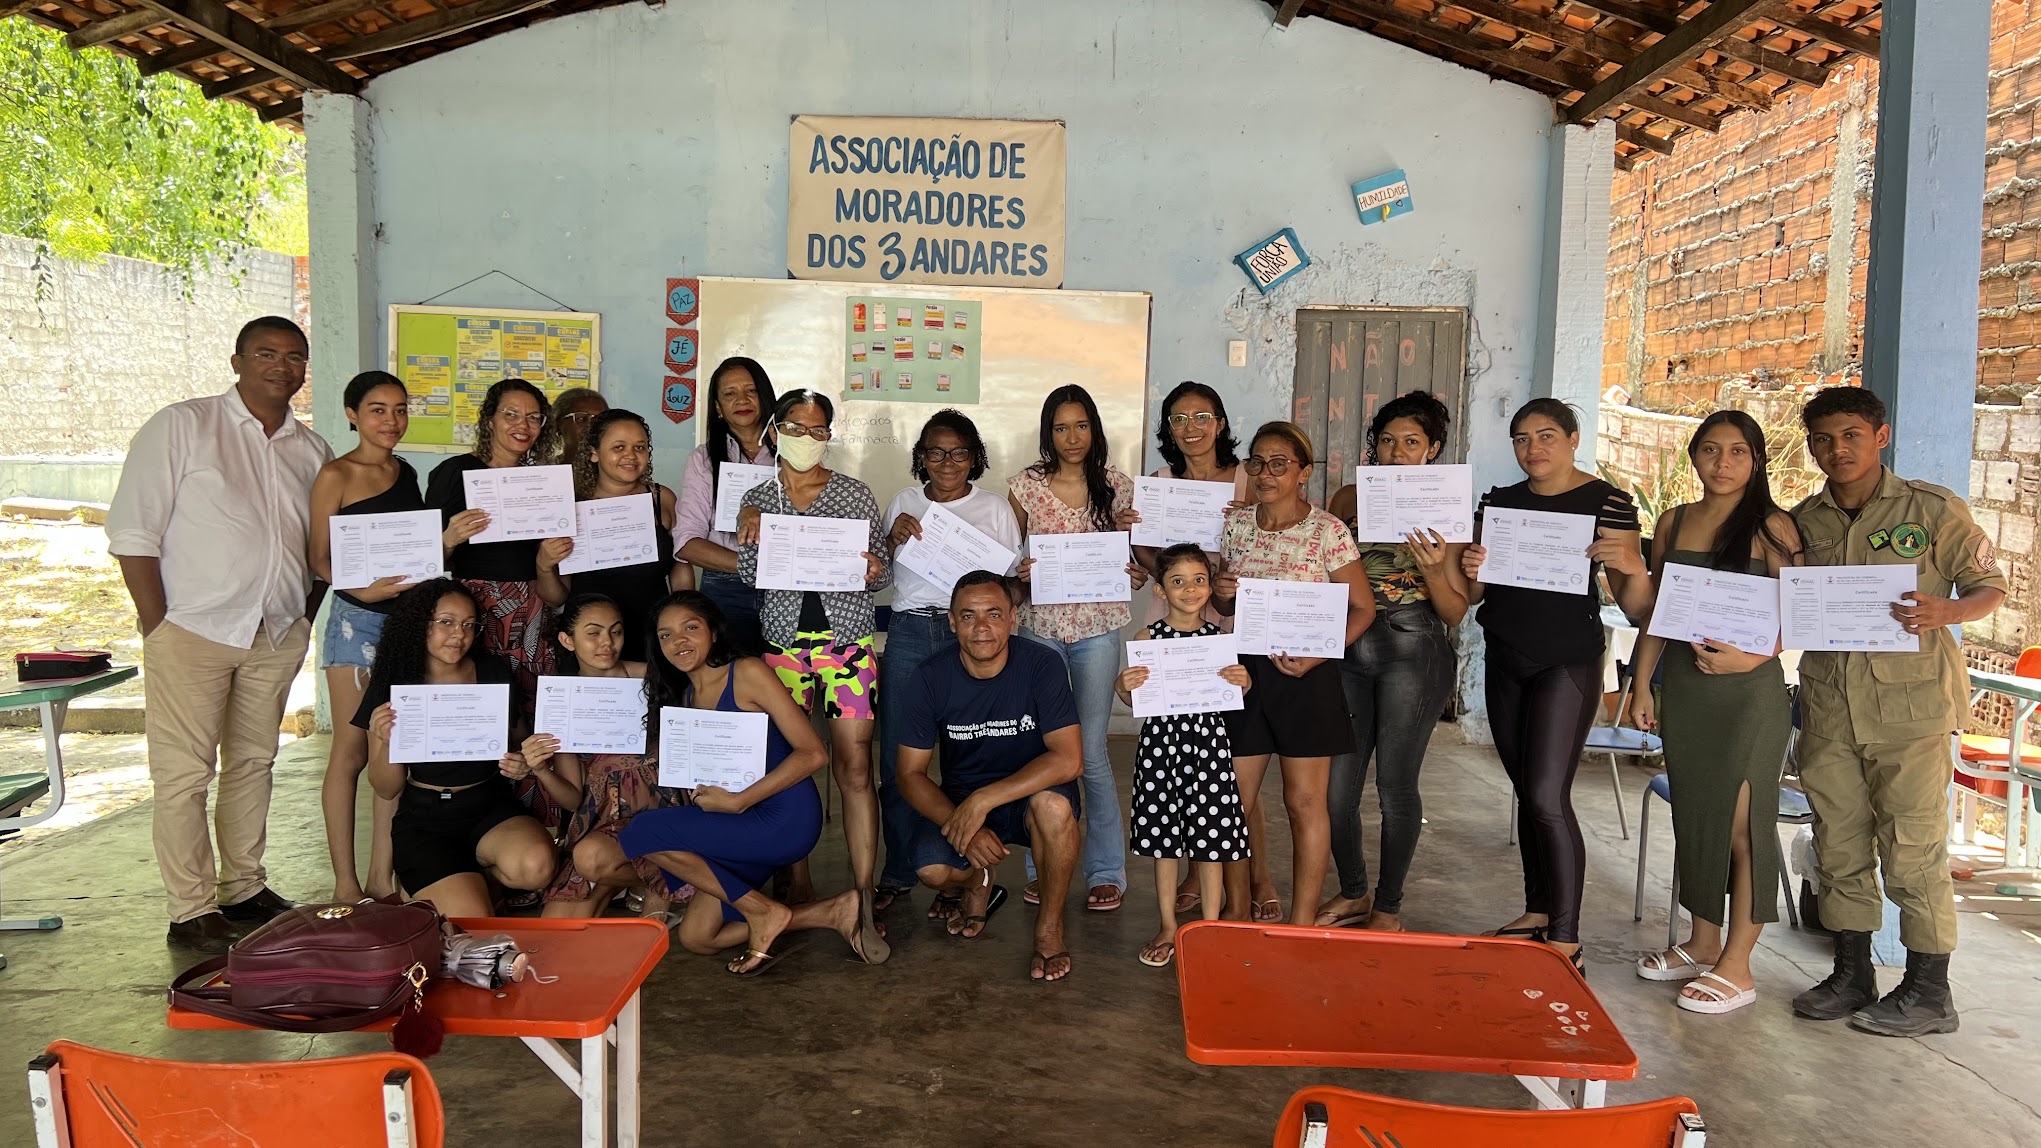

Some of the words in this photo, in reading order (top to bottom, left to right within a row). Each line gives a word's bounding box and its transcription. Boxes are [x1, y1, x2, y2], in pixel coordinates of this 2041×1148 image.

[809, 132, 981, 184] ASSOCIAÇÃO
[988, 141, 1026, 180] DE
[835, 188, 1026, 230] MORADORES
[1358, 184, 1408, 210] HUMILDADE
[807, 233, 866, 269] DOS
[877, 231, 907, 281] 3
[909, 237, 1048, 277] ANDARES
[1259, 256, 1288, 284] UNIÃO
[1330, 331, 1416, 374] NÃO
[1294, 392, 1448, 425] ENT
[948, 731, 974, 741] BAIRRO
